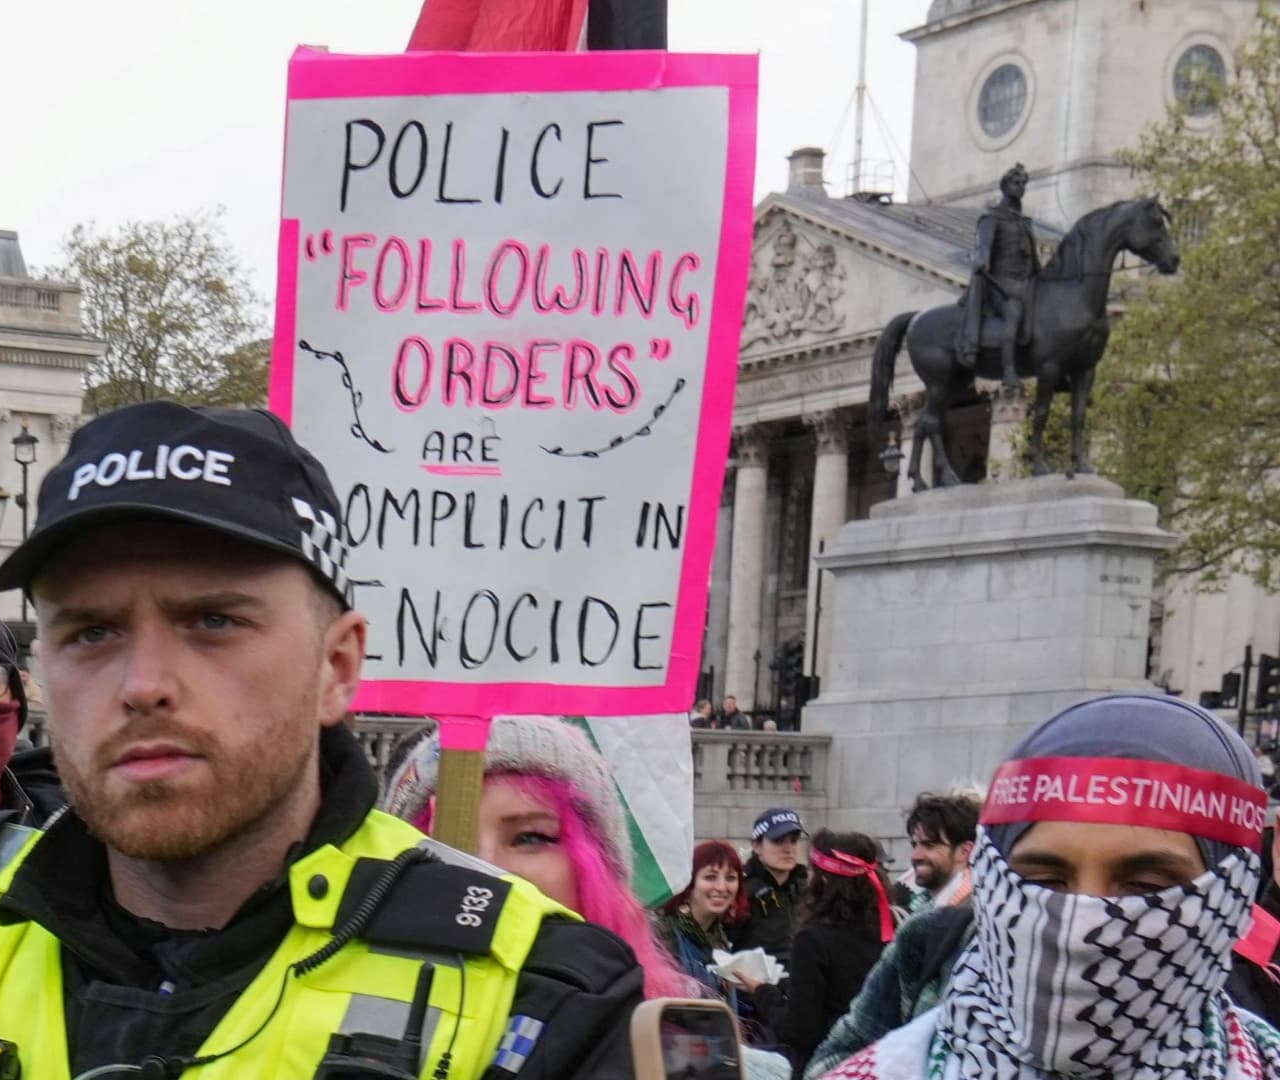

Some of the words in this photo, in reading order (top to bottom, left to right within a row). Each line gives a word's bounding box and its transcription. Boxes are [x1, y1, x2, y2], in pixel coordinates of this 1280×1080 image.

[341, 119, 624, 212] POLICE
[67, 444, 235, 501] POLICE
[421, 431, 500, 464] ARE
[342, 483, 606, 551] OMPLICIT
[636, 502, 684, 550] IN
[348, 581, 671, 670] ENOCIDE
[993, 775, 1032, 804] FREE
[1033, 774, 1226, 825] PALESTINIAN
[455, 885, 493, 928] 9133
